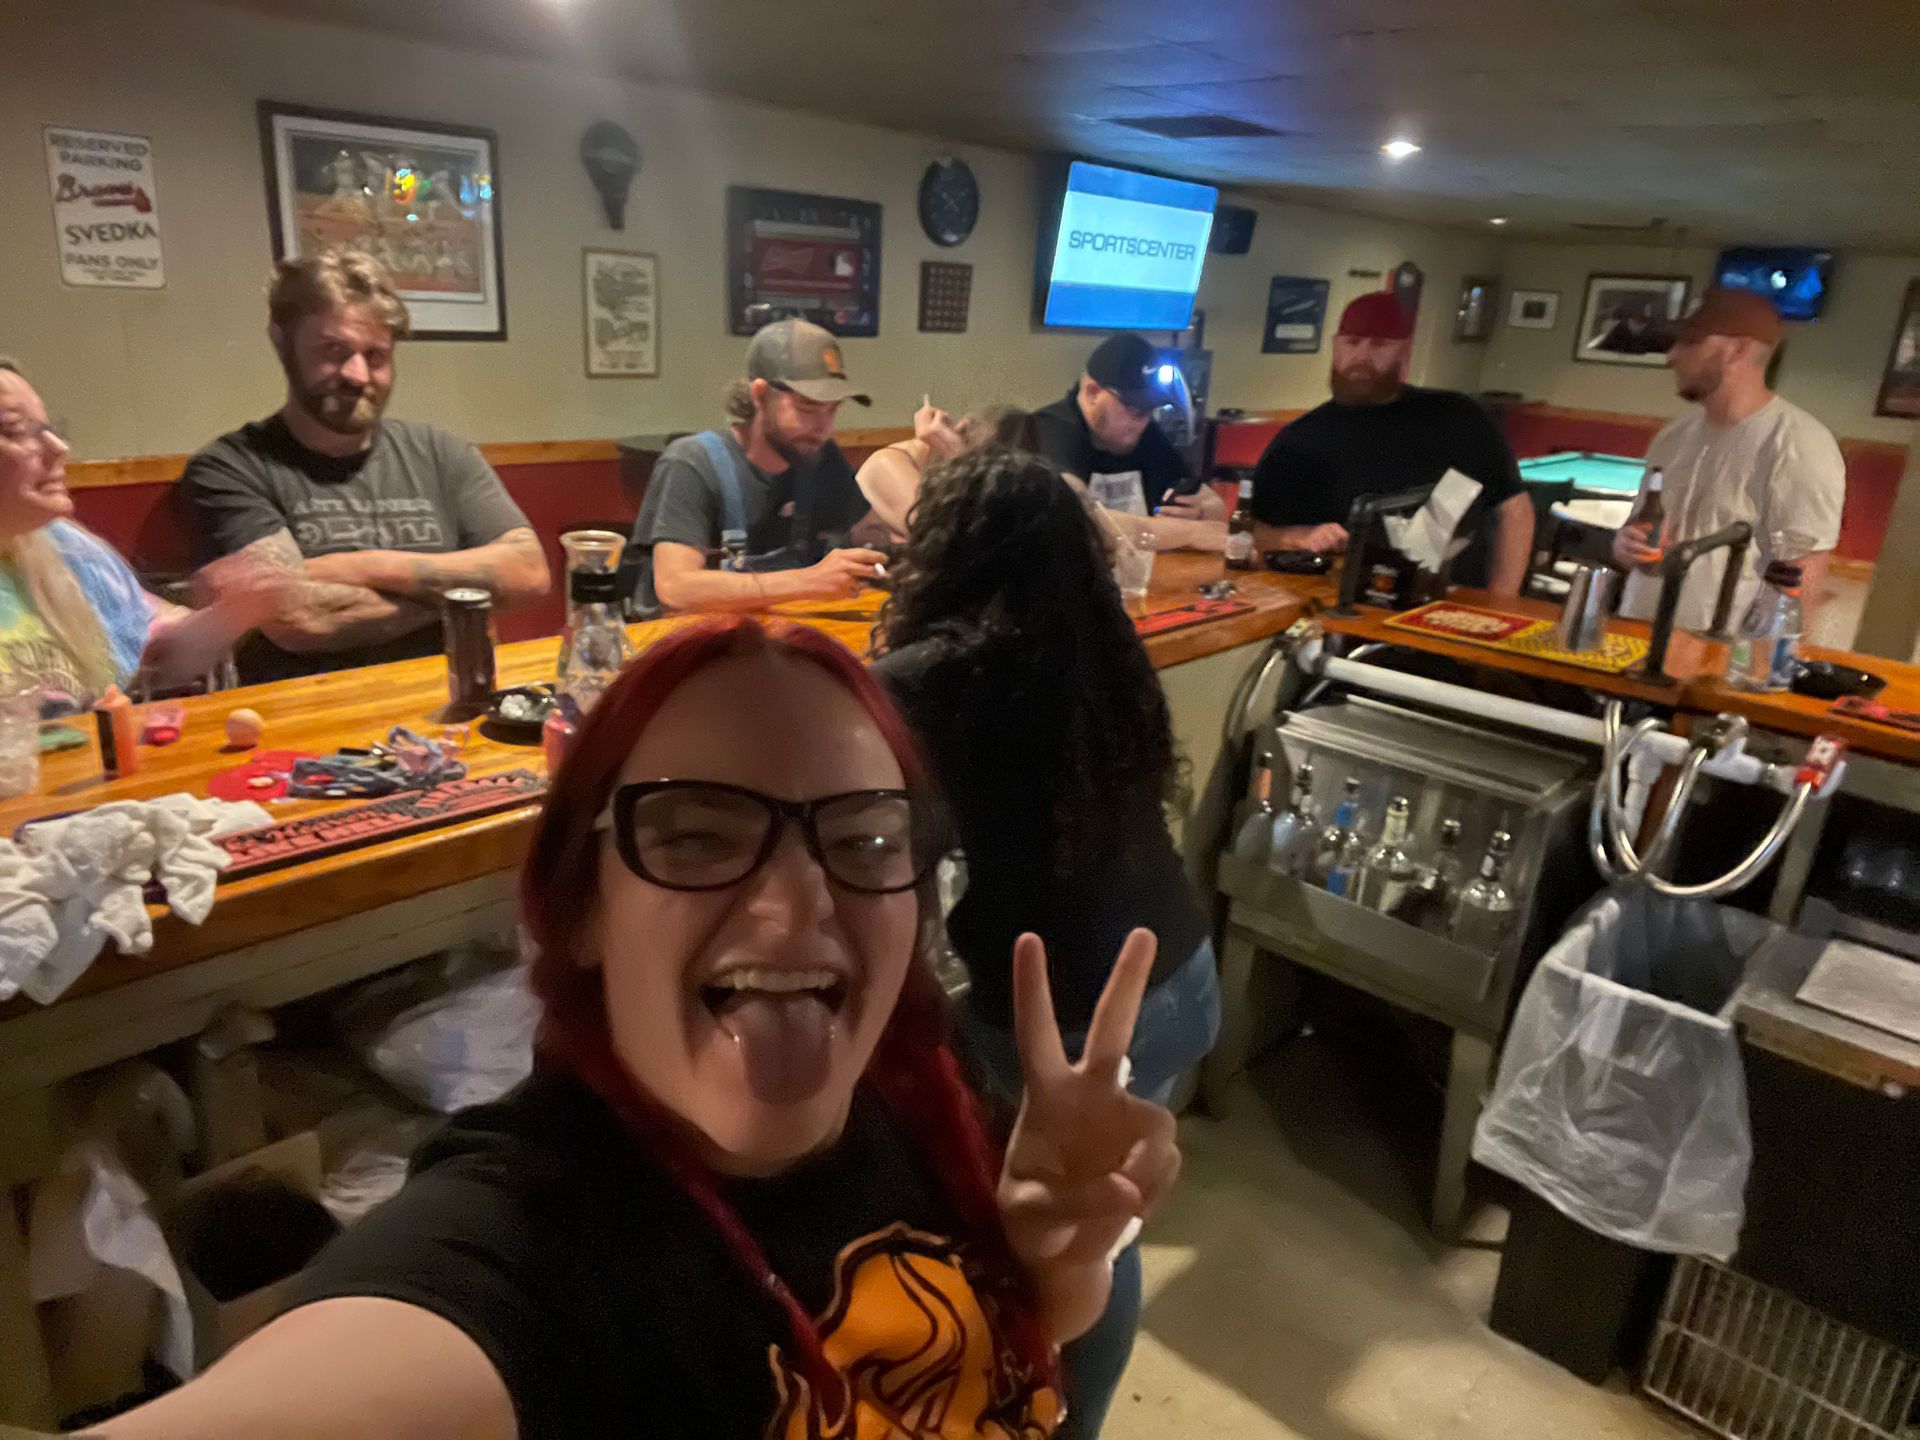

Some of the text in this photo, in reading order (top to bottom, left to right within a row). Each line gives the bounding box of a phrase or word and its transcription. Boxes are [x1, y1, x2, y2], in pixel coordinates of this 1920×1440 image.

[48, 132, 148, 156] RESERVED
[59, 150, 142, 171] PARKING
[65, 222, 158, 245] SVEDKA
[1068, 230, 1196, 260] SPORTSCENTER
[115, 256, 158, 270] ONLY
